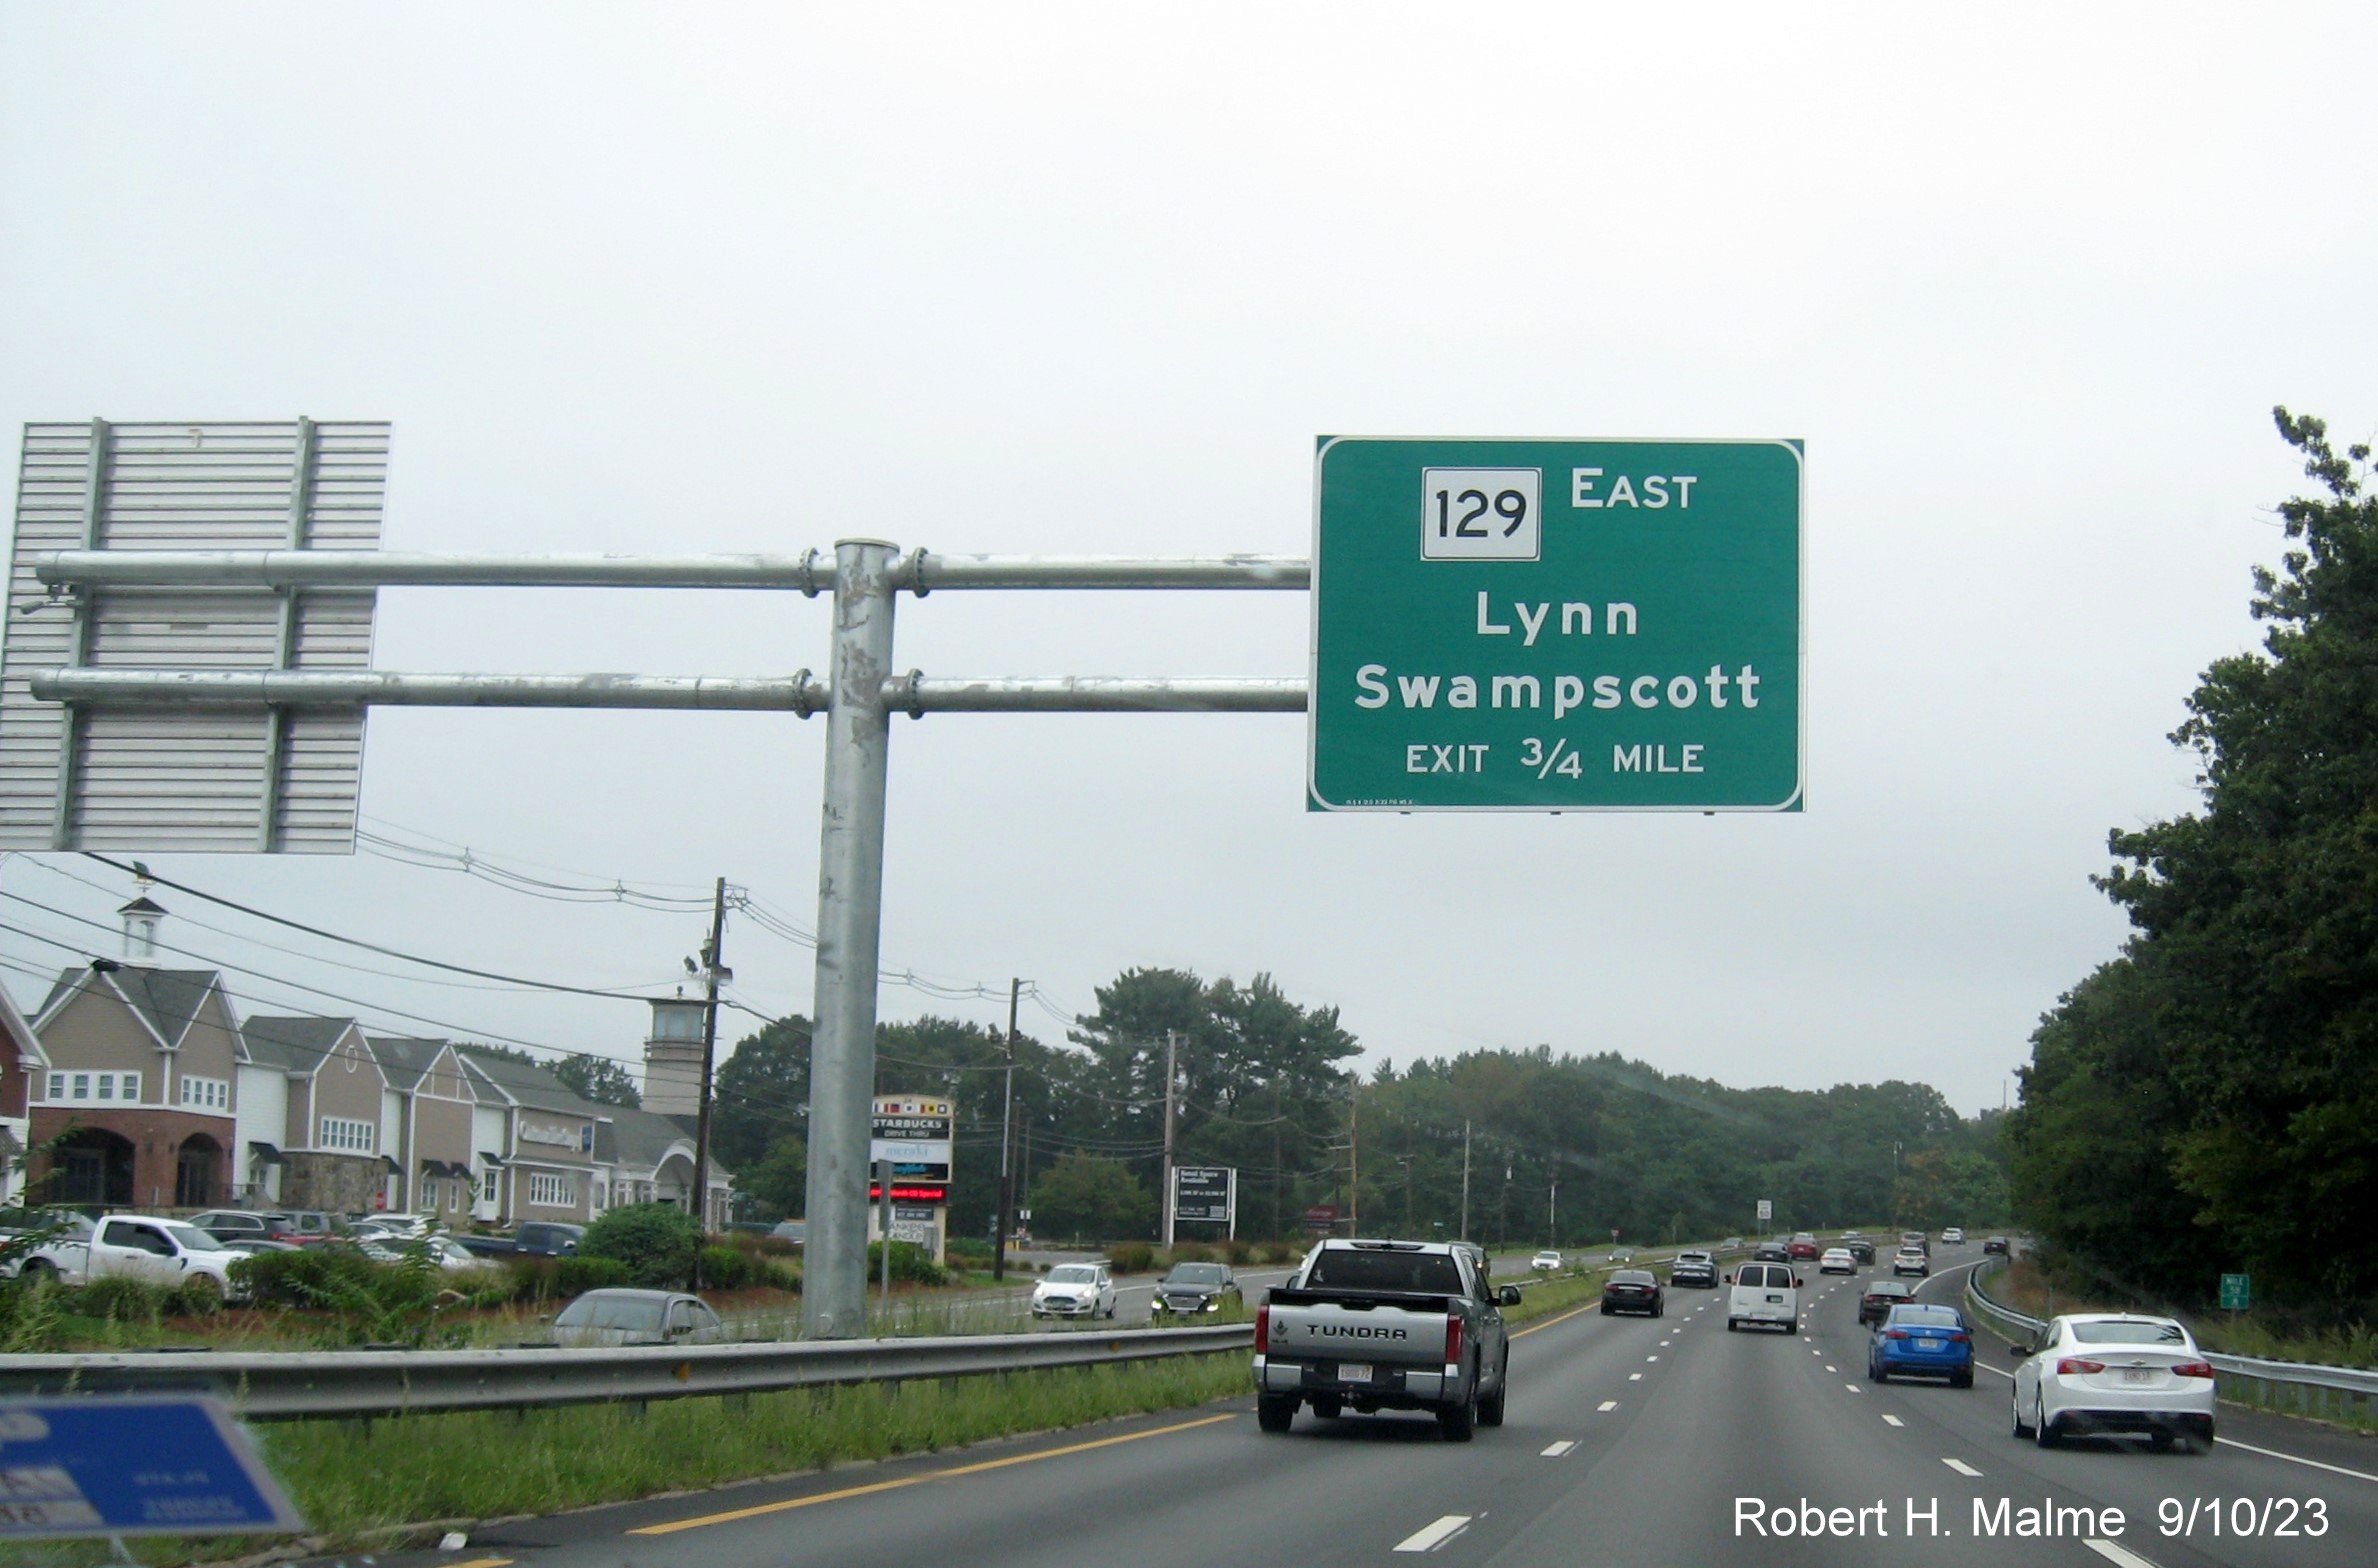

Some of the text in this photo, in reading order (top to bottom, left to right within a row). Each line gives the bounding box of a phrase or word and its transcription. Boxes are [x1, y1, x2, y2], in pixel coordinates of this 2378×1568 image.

[1570, 467, 1698, 509] EAST
[1435, 490, 1527, 538] 129
[1477, 591, 1638, 647] Lynn
[1354, 664, 1761, 720] Swampscott
[1406, 738, 1704, 780] EXIT 3/4 MILE
[872, 1119, 942, 1129] STARBUCKS
[884, 1130, 907, 1138] DRIVE
[1307, 1324, 1407, 1341] TUNDRA
